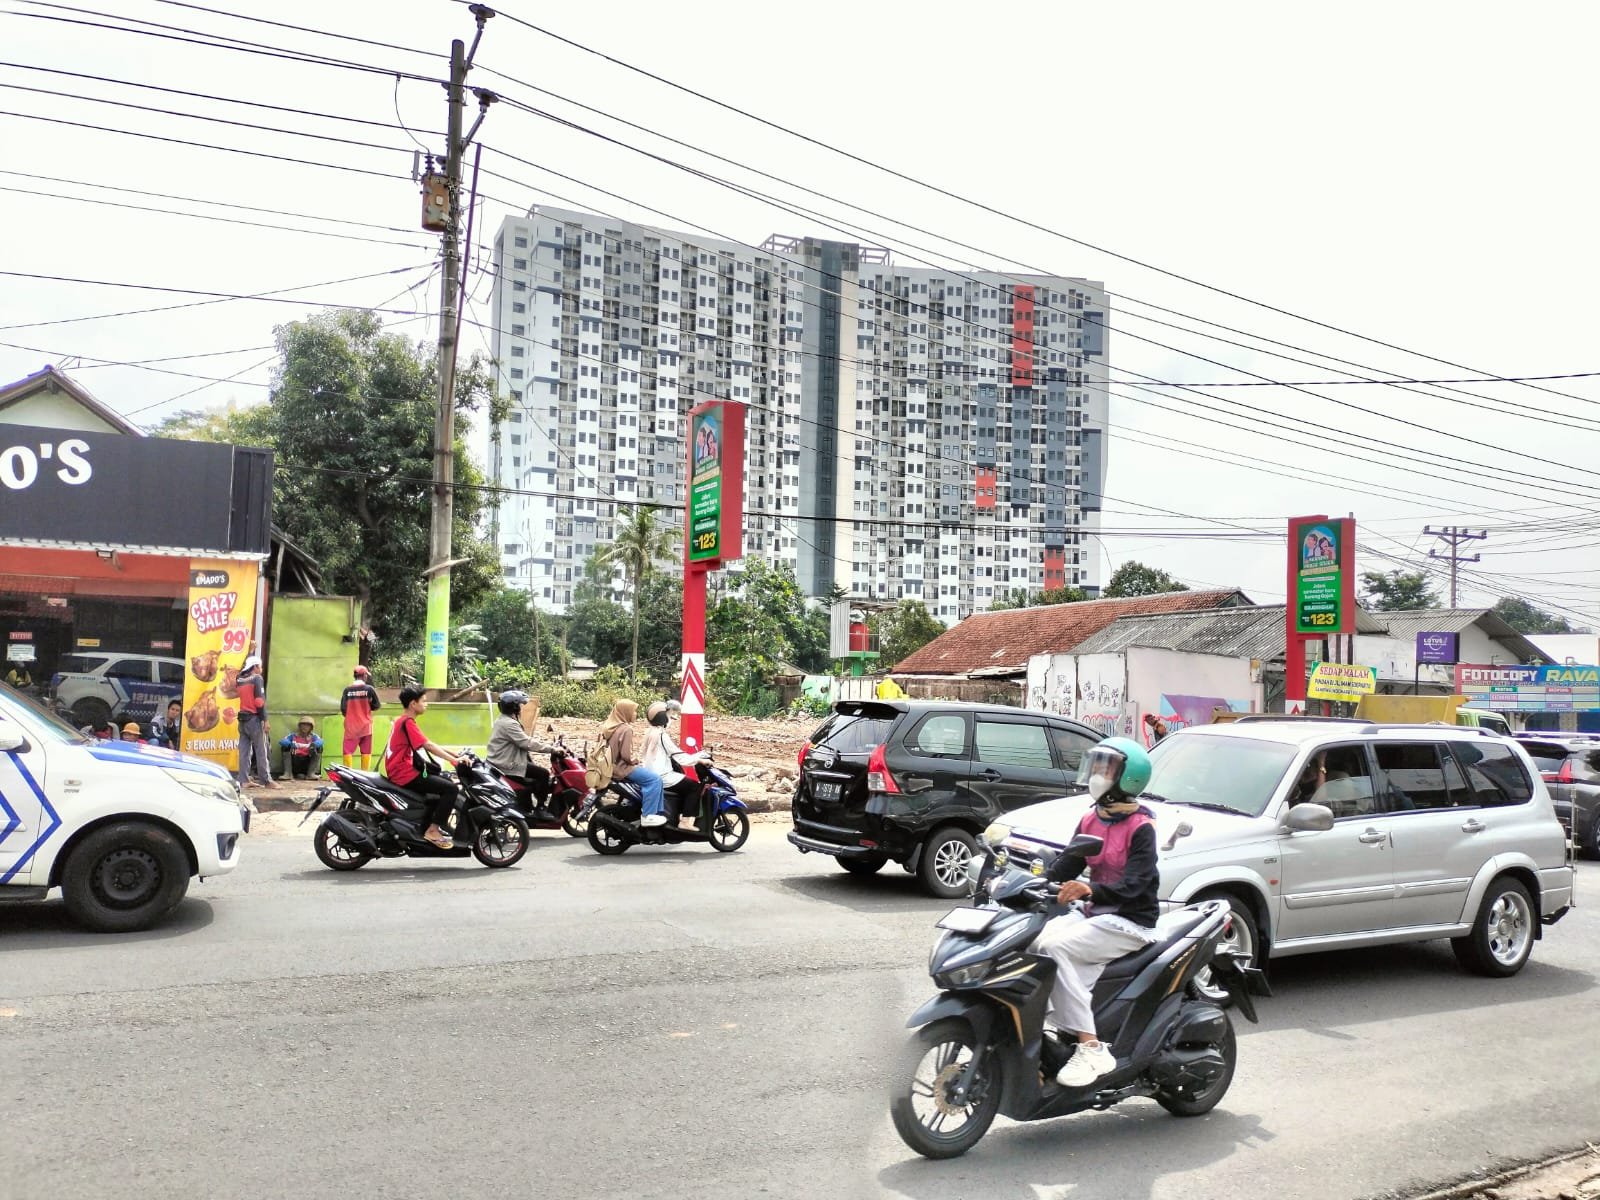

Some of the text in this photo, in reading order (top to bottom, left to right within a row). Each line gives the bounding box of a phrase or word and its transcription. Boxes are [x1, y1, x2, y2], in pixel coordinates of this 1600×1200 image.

[0, 439, 92, 489] O'S
[699, 532, 716, 550] 123
[191, 593, 237, 619] CRAZY
[197, 611, 229, 632] SALE
[1310, 613, 1334, 625] 123
[1320, 666, 1369, 679] SEDAP MALAM
[1461, 668, 1599, 682] FOTOCOPY RAVA
[193, 739, 216, 751] EKOR
